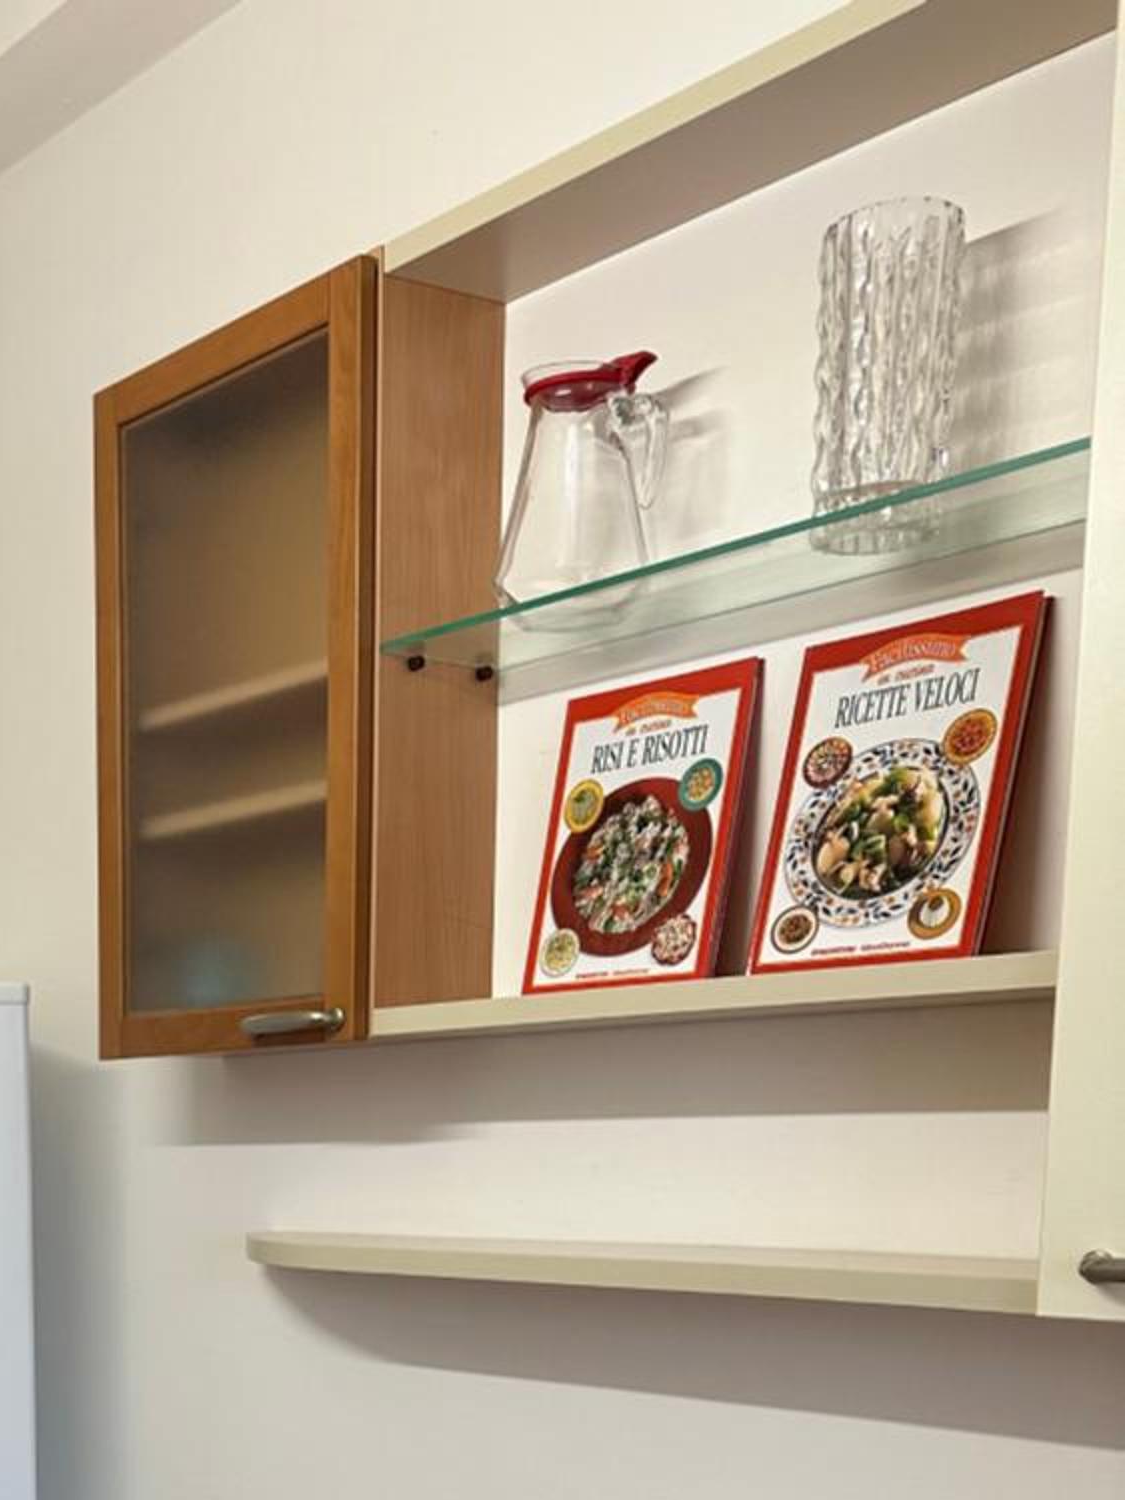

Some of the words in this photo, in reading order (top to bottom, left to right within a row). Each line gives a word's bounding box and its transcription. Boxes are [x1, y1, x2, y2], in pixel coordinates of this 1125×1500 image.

[834, 683, 911, 729] RICETTE
[914, 667, 981, 712] VELOCI
[591, 740, 624, 774] RISI
[626, 738, 640, 768] E
[641, 723, 709, 766] RISOTTI
